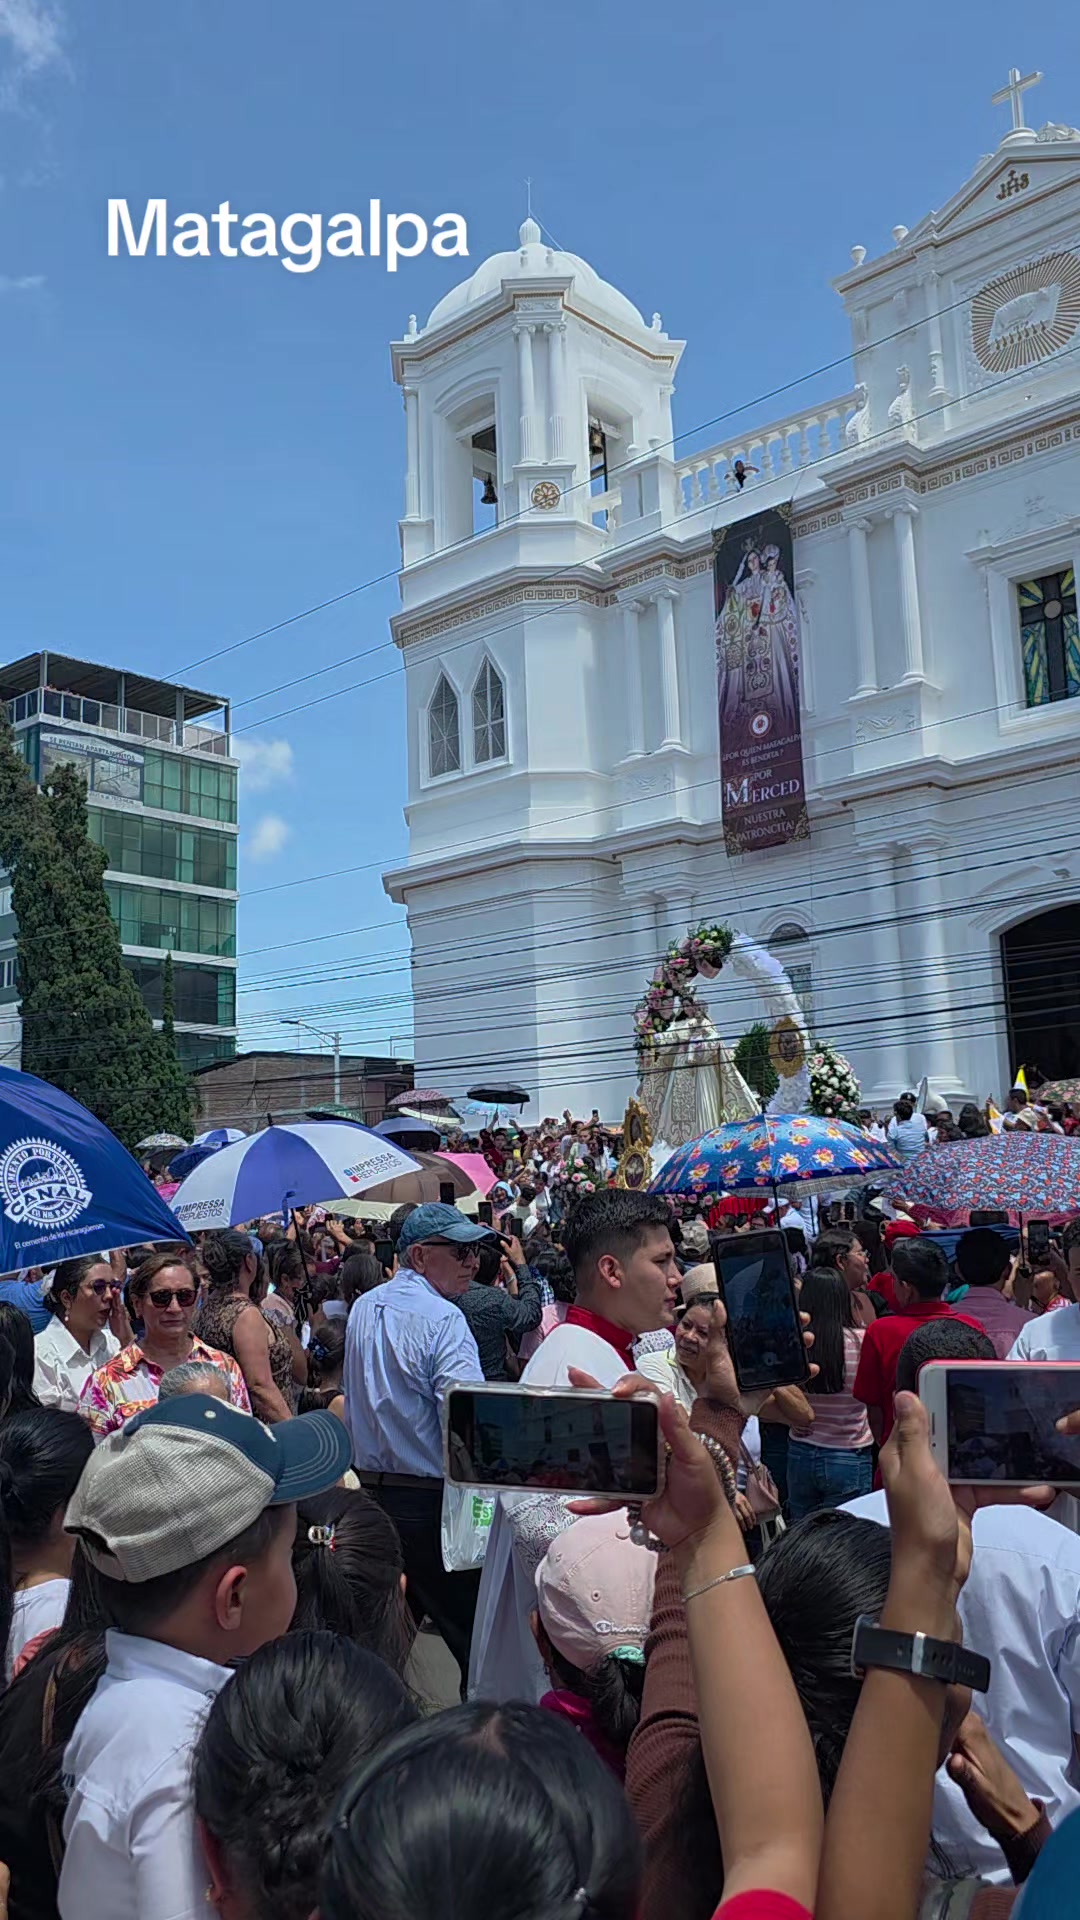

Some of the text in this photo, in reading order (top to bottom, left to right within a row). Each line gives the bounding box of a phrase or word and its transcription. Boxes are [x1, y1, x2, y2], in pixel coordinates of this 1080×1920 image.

[726, 778, 800, 808] MERCED
[744, 808, 786, 825] NUESTRA
[8, 1148, 76, 1196] CEMENTO PORTLAND
[350, 1153, 396, 1173] IMPRESSA
[356, 1159, 402, 1180] REPUESTOS
[10, 1185, 87, 1216] CANAL
[181, 1199, 225, 1213] IMPRESSA
[179, 1208, 223, 1221] REPUESTOS
[14, 1241, 21, 1249] El
[22, 1236, 49, 1247] cemento
[49, 1233, 57, 1241] de
